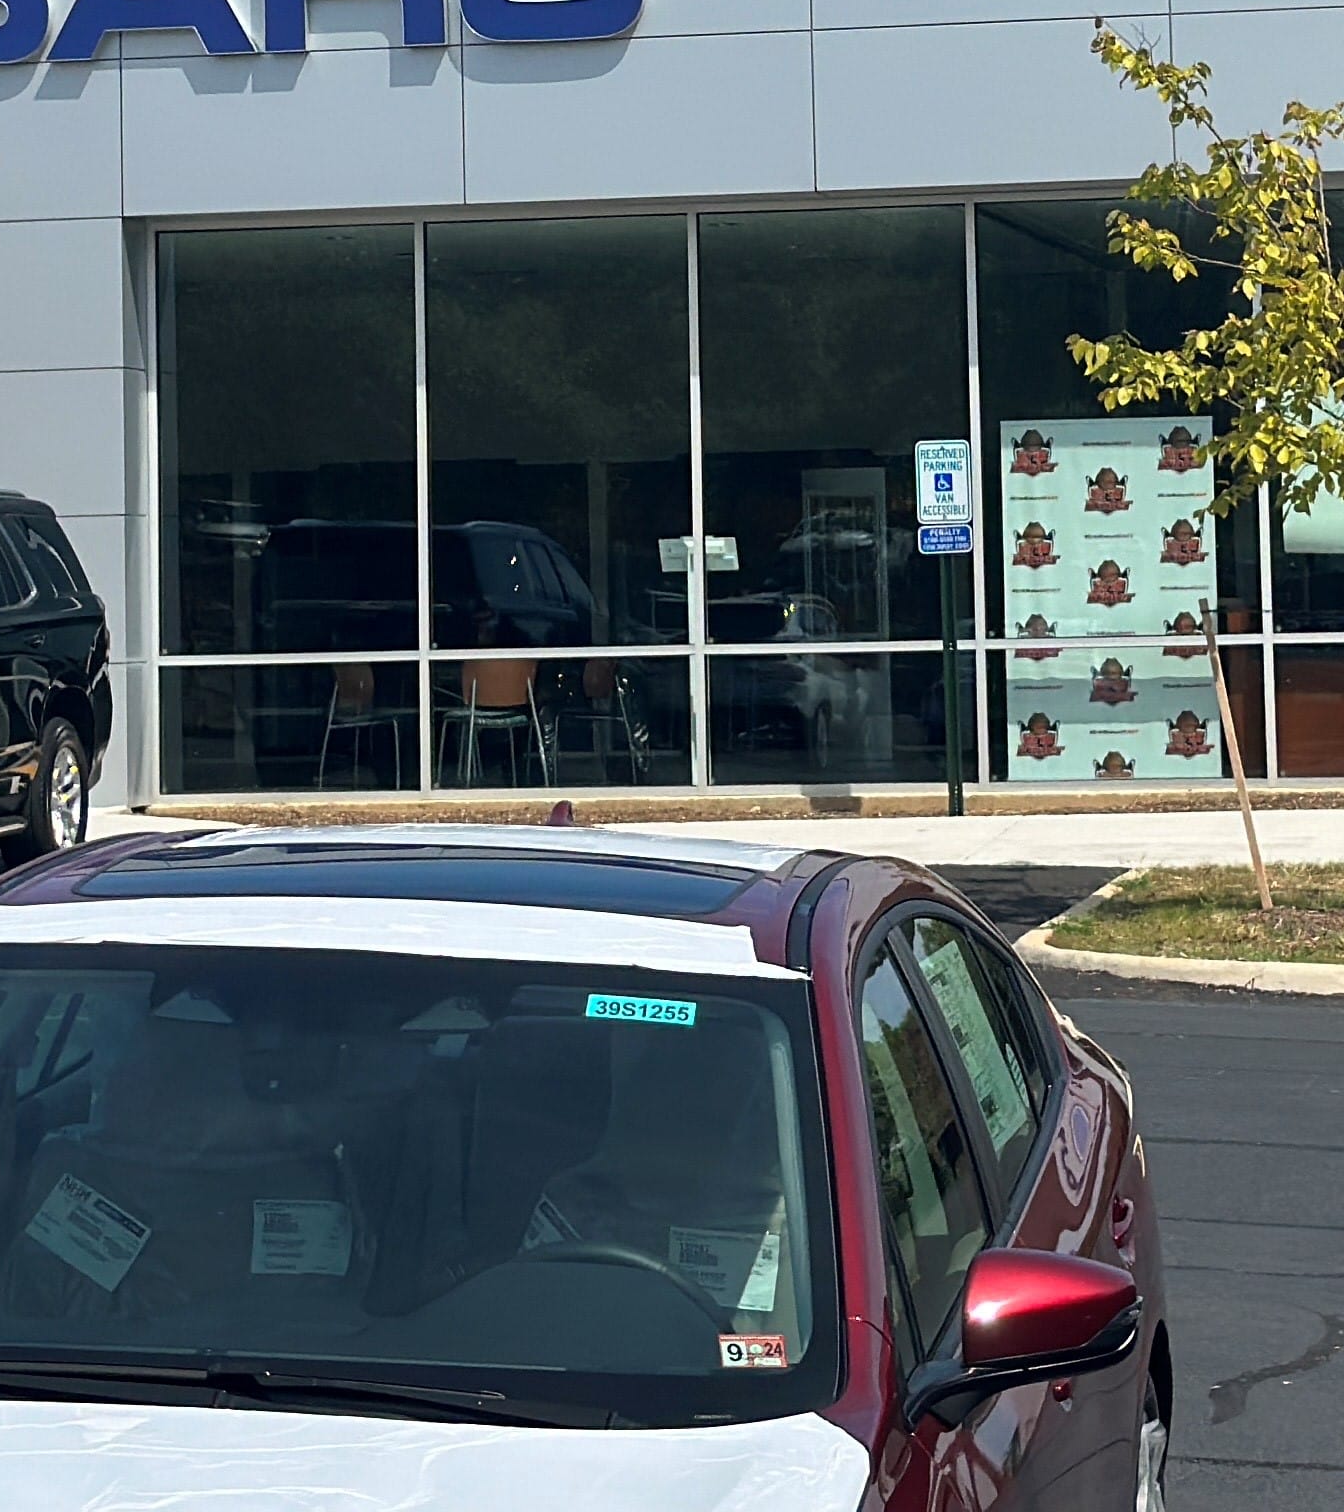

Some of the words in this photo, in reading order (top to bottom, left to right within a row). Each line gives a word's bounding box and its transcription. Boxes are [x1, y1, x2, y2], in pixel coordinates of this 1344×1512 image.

[920, 448, 965, 459] RESERVED
[923, 461, 963, 471] PARKING
[935, 493, 954, 503] VAN
[923, 504, 966, 516] ACCESSIBLE
[595, 1000, 689, 1021] 39S1255
[727, 1343, 743, 1362] 9
[764, 1342, 782, 1357] 24
